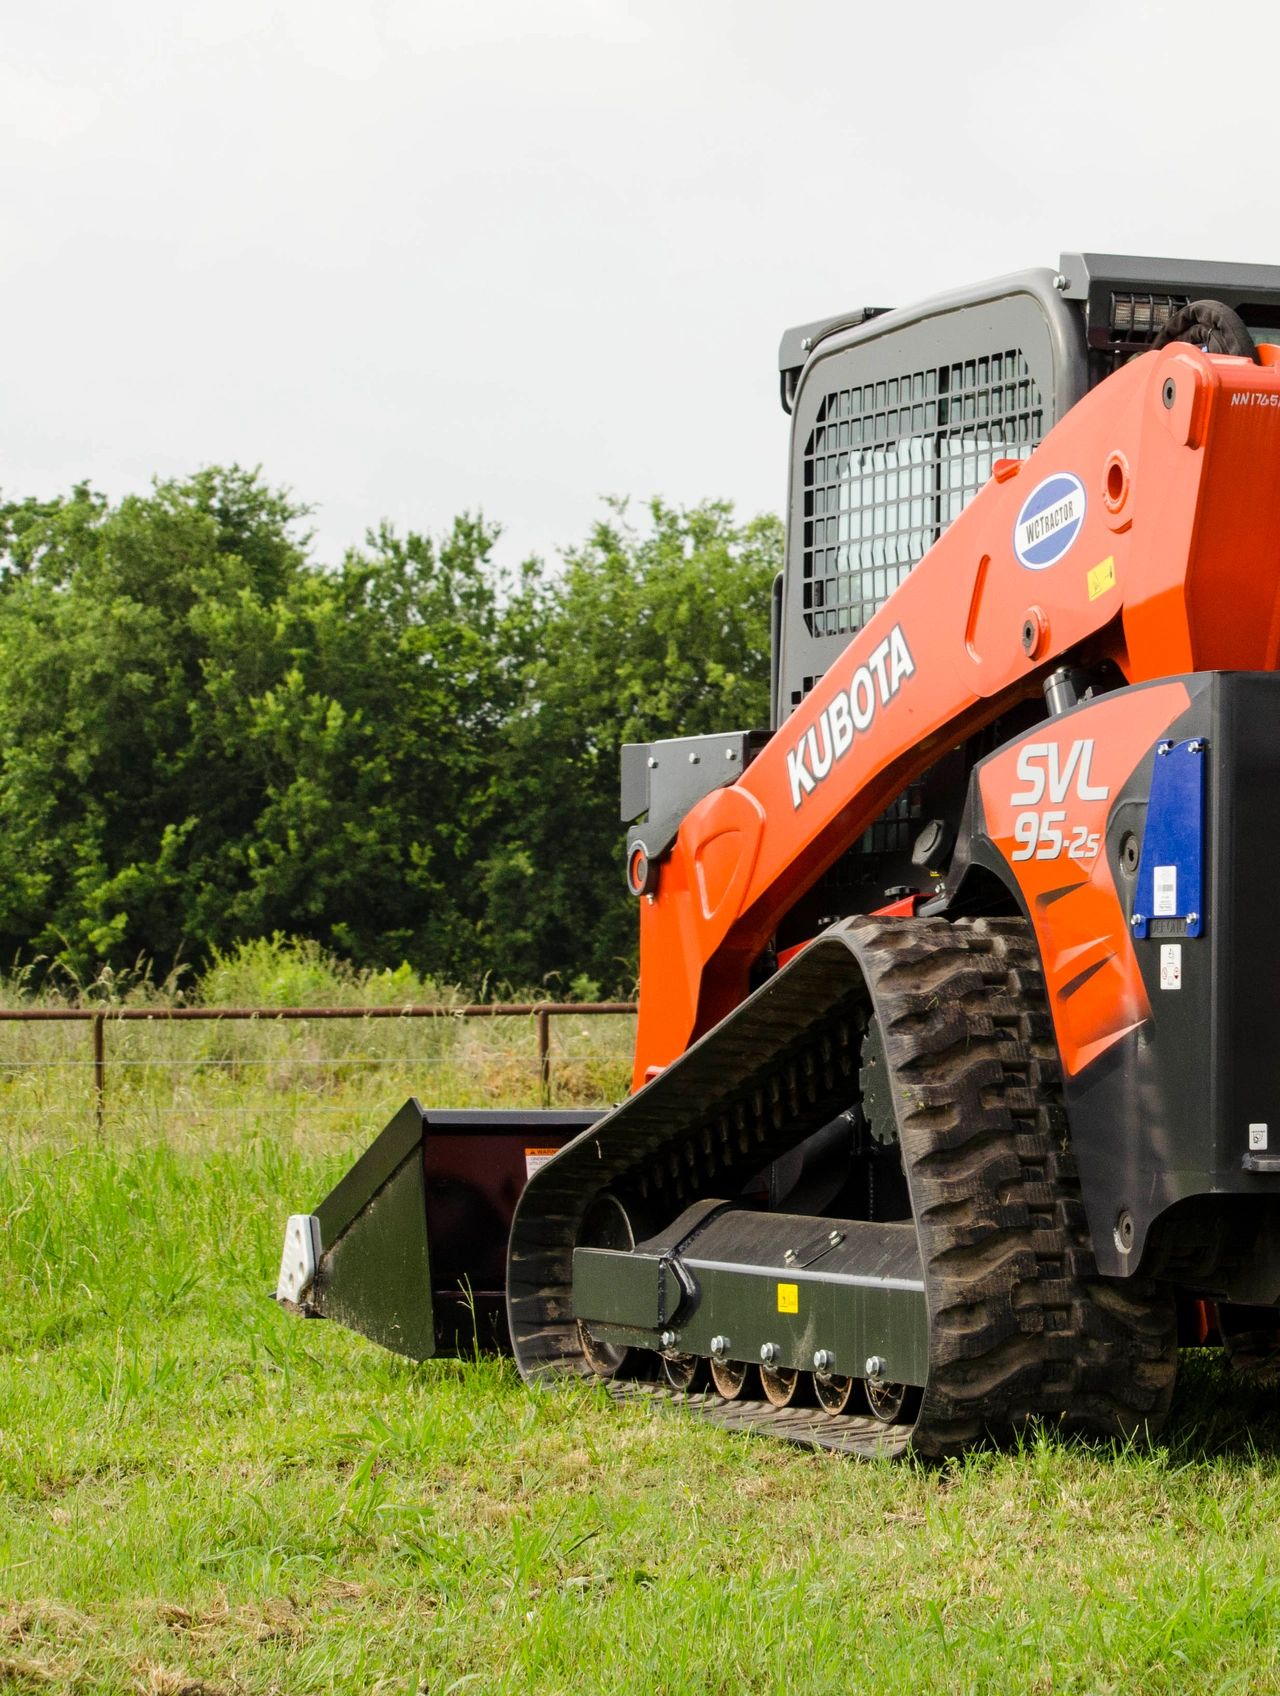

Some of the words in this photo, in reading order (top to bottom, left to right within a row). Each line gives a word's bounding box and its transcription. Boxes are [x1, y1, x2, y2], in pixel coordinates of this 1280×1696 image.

[1025, 500, 1074, 545] WCTRACTOR
[786, 623, 915, 809] KUBOTA
[1010, 738, 1109, 807] SVL
